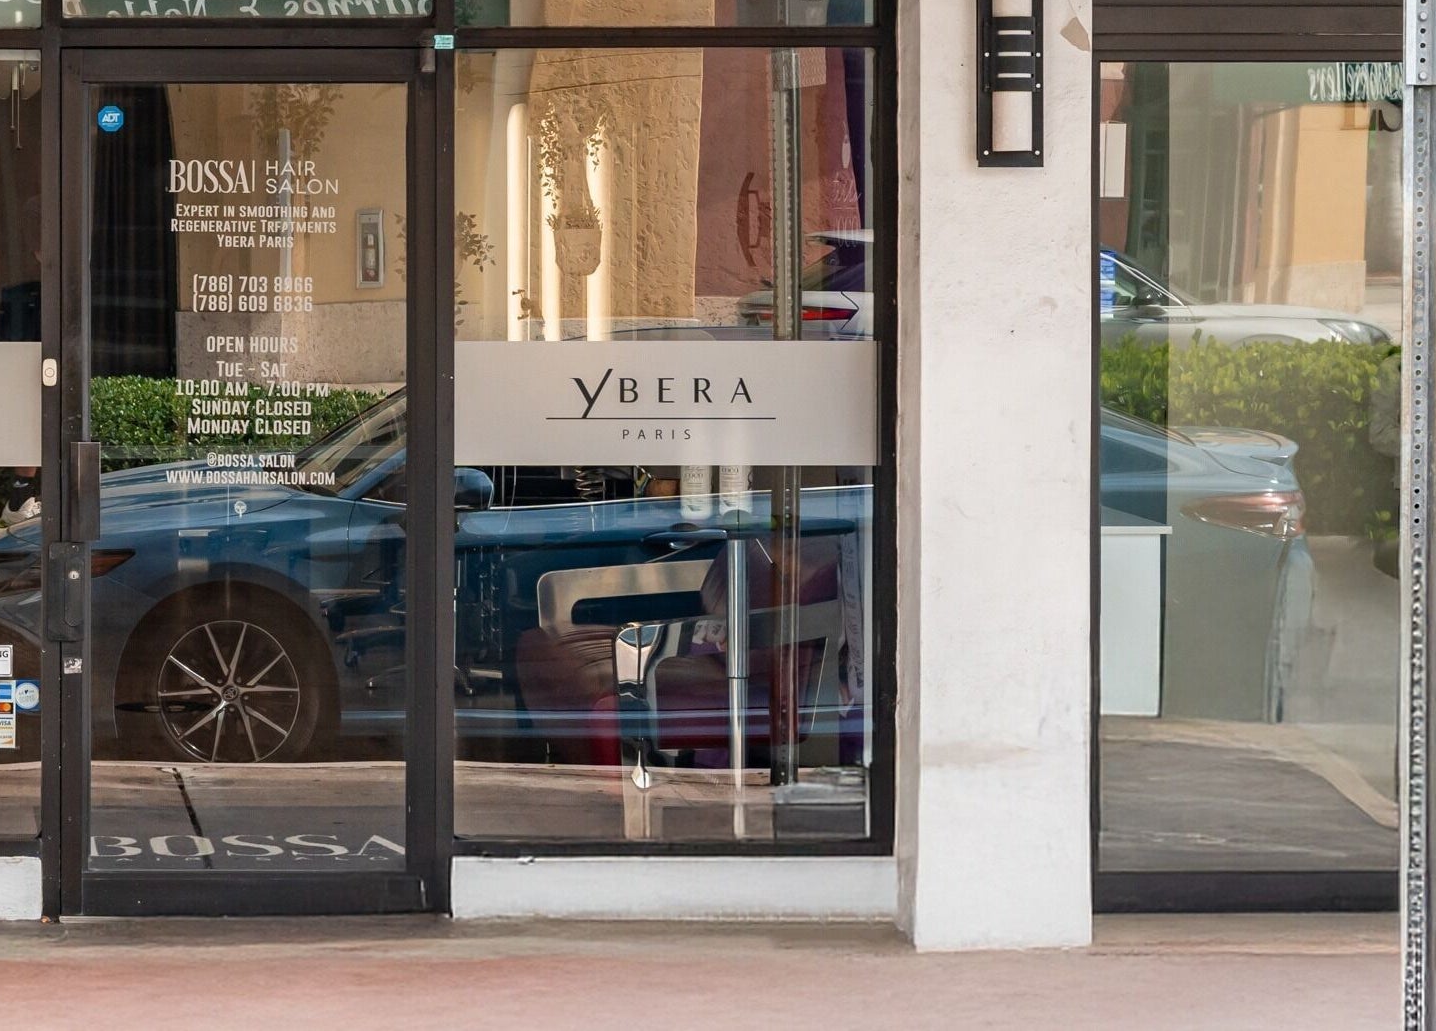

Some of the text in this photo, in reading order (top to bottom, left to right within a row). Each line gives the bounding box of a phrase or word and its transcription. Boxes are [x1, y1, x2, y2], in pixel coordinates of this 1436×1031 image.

[102, 113, 120, 123] ADT
[168, 159, 251, 193] BOSSA
[266, 160, 316, 176] HAIR
[266, 178, 339, 195] SALON
[238, 276, 268, 293] 703
[238, 295, 268, 312] 609
[273, 295, 312, 312] 6836
[206, 336, 298, 353] OPEN HOURS
[175, 379, 220, 396] 10:00
[225, 381, 248, 396] AM
[267, 380, 300, 397] 7:00
[306, 382, 330, 398] PM
[570, 368, 753, 418] YBERA
[622, 428, 693, 440] PARIS
[206, 451, 295, 468] @BOSSA.SALON
[165, 470, 336, 486] WWW.BOSSAHAIRSALON.COM
